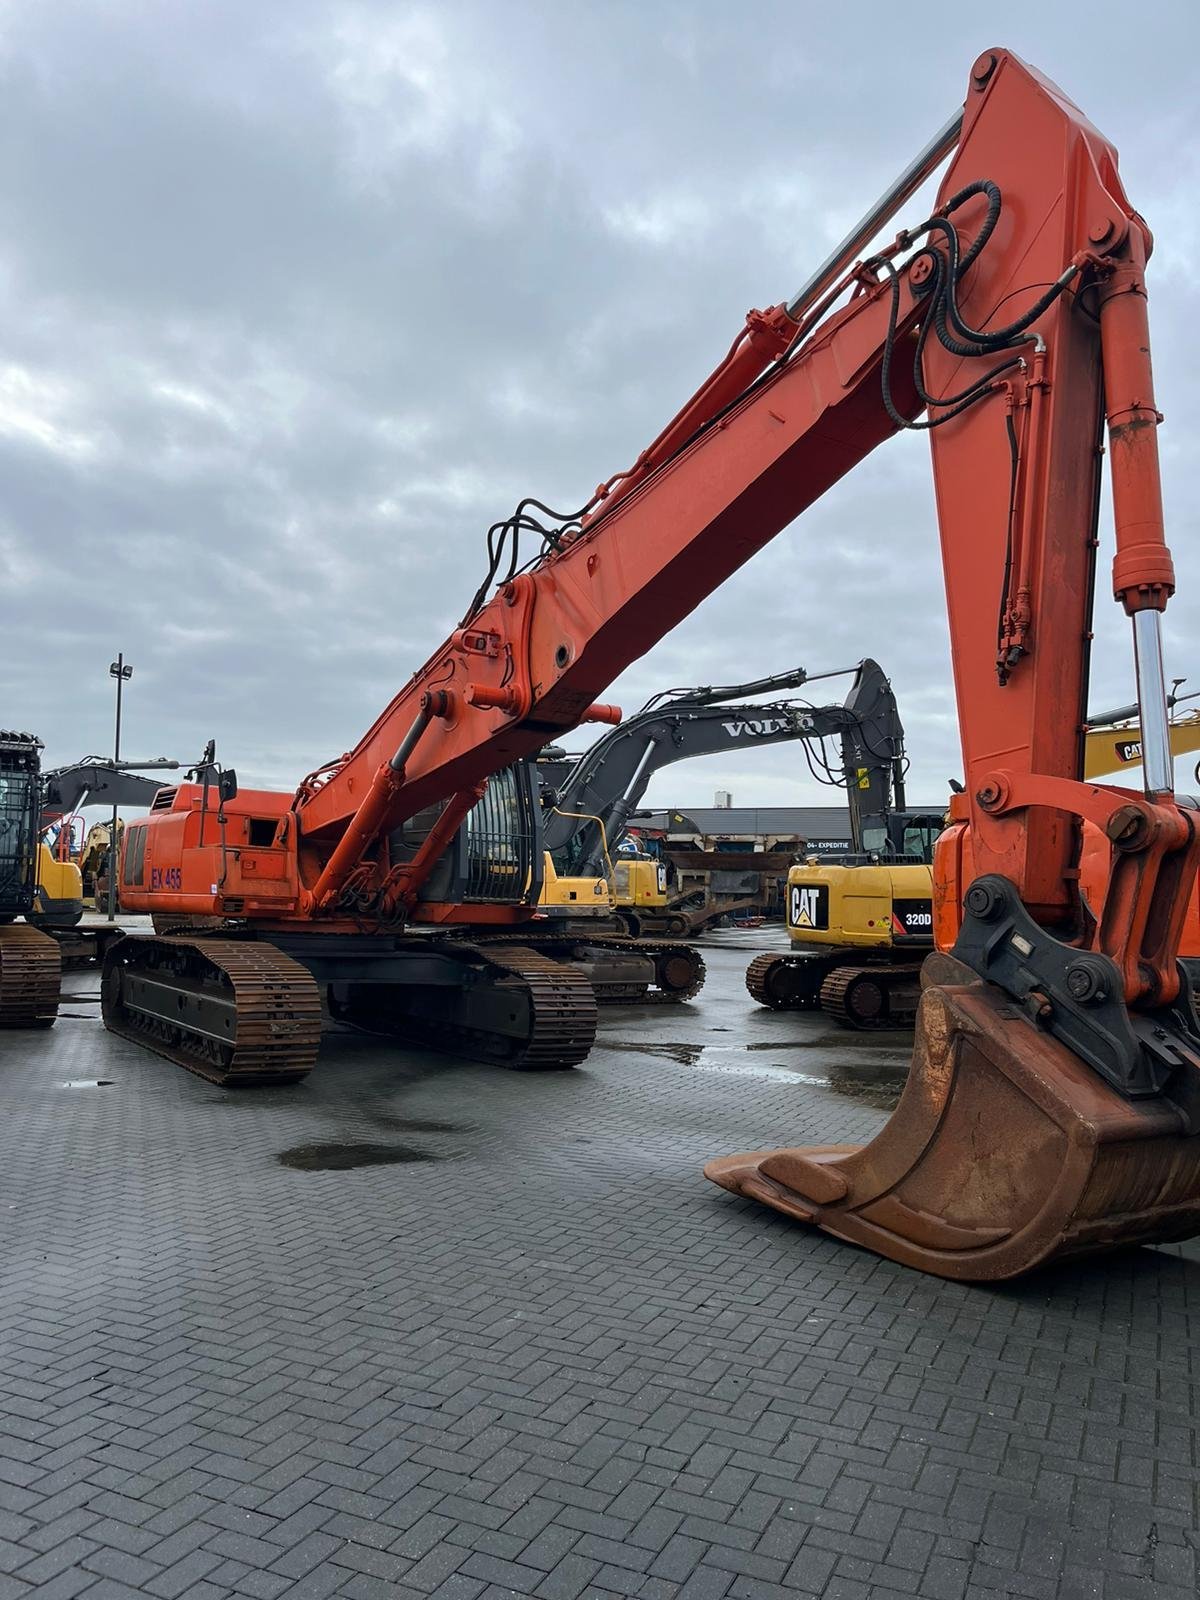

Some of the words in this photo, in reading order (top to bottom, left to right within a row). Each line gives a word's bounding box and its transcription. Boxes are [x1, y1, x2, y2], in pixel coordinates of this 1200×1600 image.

[152, 868, 164, 889] EX
[165, 867, 182, 889] 455
[792, 887, 819, 927] CAT
[906, 913, 932, 926] 320D
